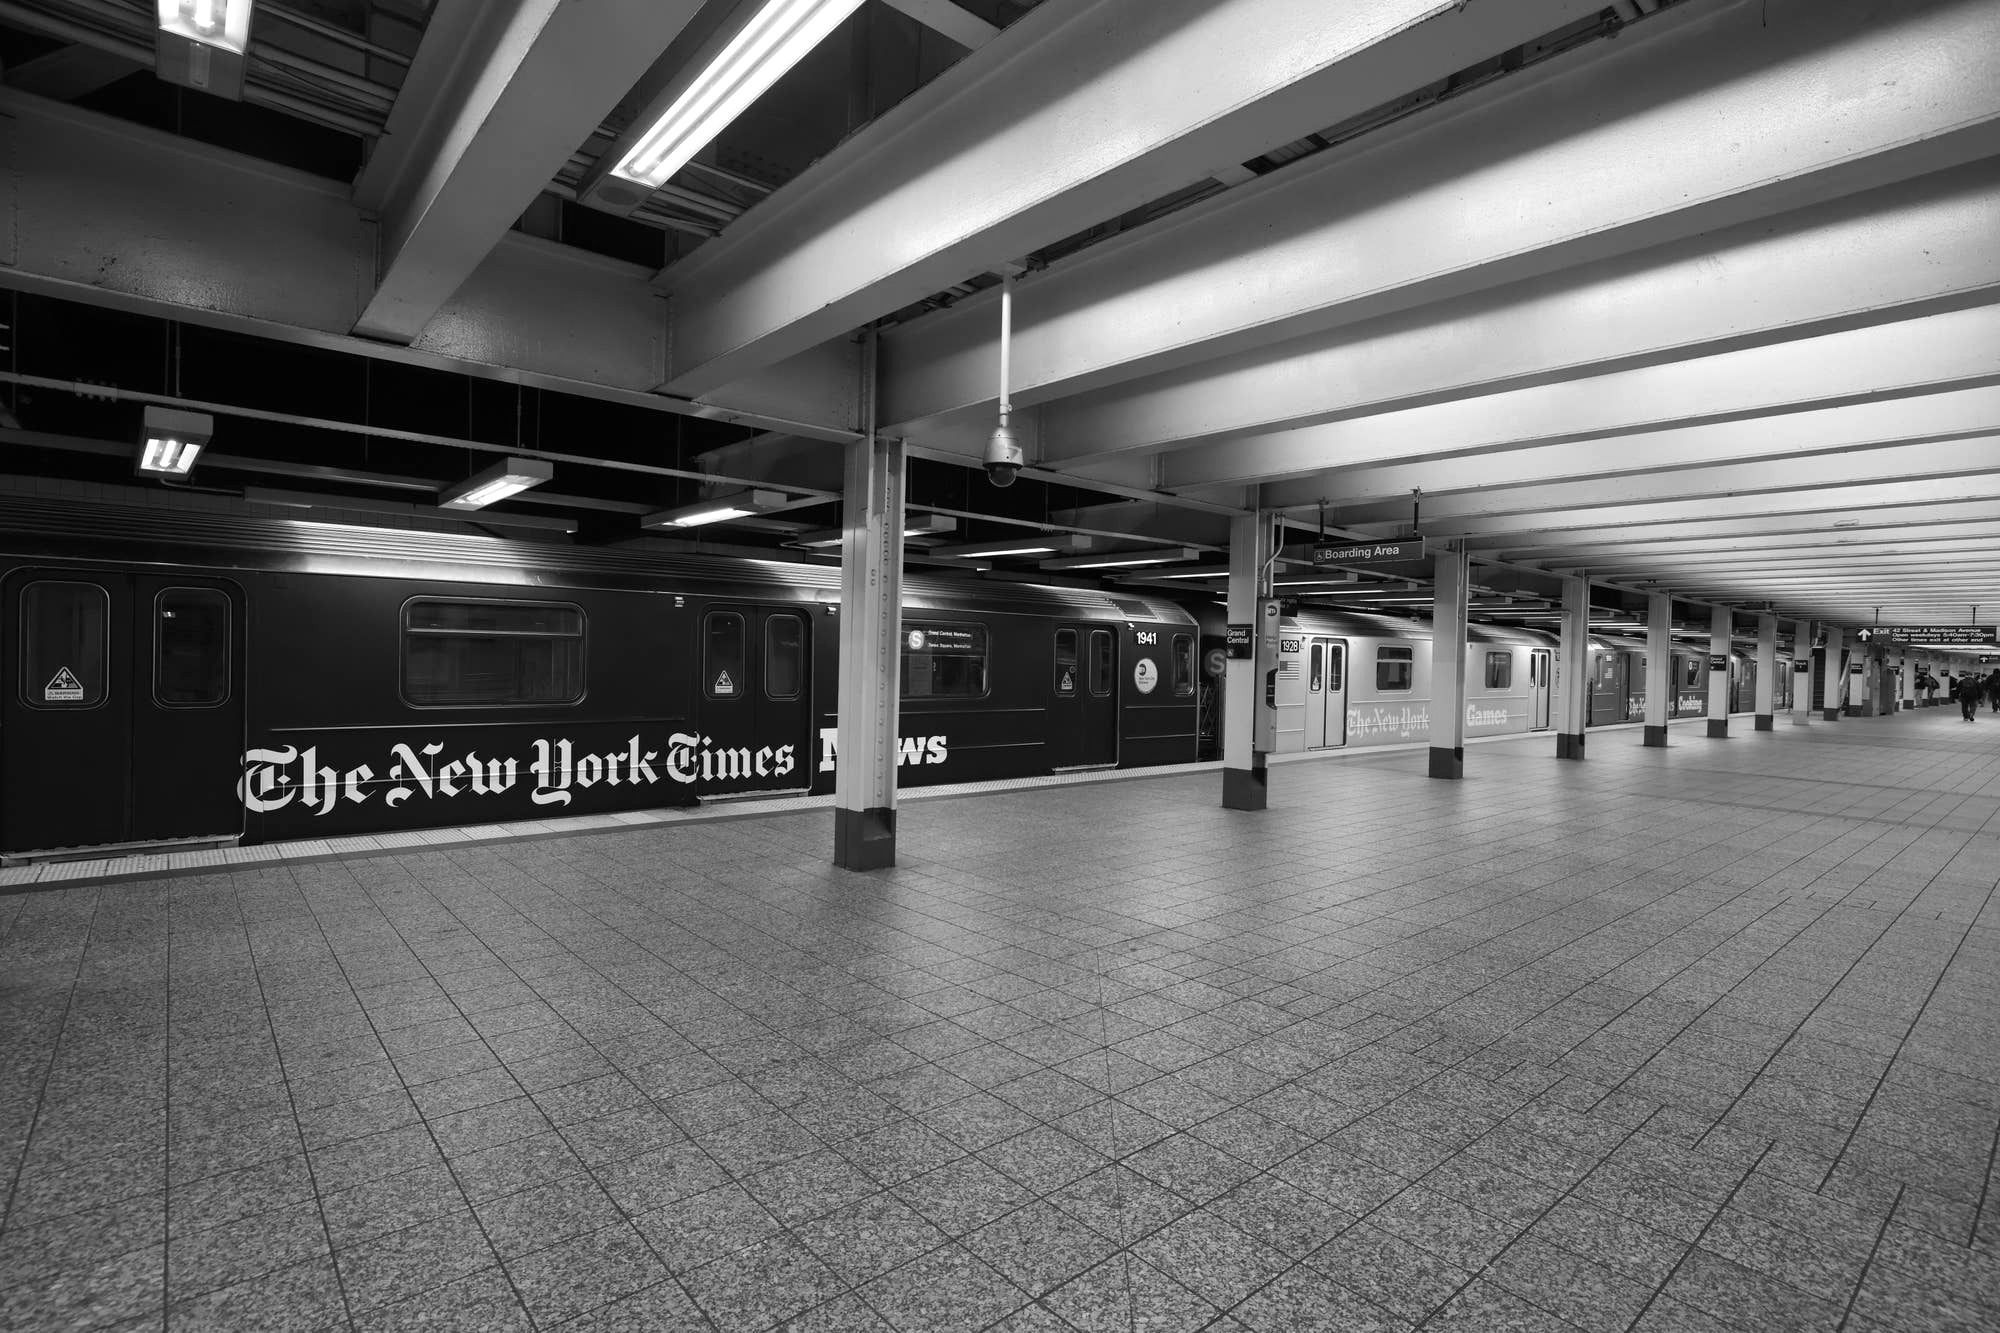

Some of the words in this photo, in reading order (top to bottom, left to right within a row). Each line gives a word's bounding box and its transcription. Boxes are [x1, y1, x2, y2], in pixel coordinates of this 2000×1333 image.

[1325, 548, 1371, 559] Boarding
[1374, 546, 1400, 556] Area
[911, 632, 922, 648] S
[1136, 631, 1157, 645] 1941
[1227, 629, 1246, 637] Grand
[1282, 640, 1299, 652] 1928
[1209, 652, 1226, 674] S
[1678, 695, 1703, 713] Cooking
[1346, 708, 1372, 739] The
[1372, 707, 1400, 737] New
[1400, 704, 1430, 738] York
[1466, 704, 1508, 727] Games
[237, 744, 377, 816] The
[385, 740, 520, 808] New
[529, 734, 660, 807] York
[667, 732, 796, 784] Times
